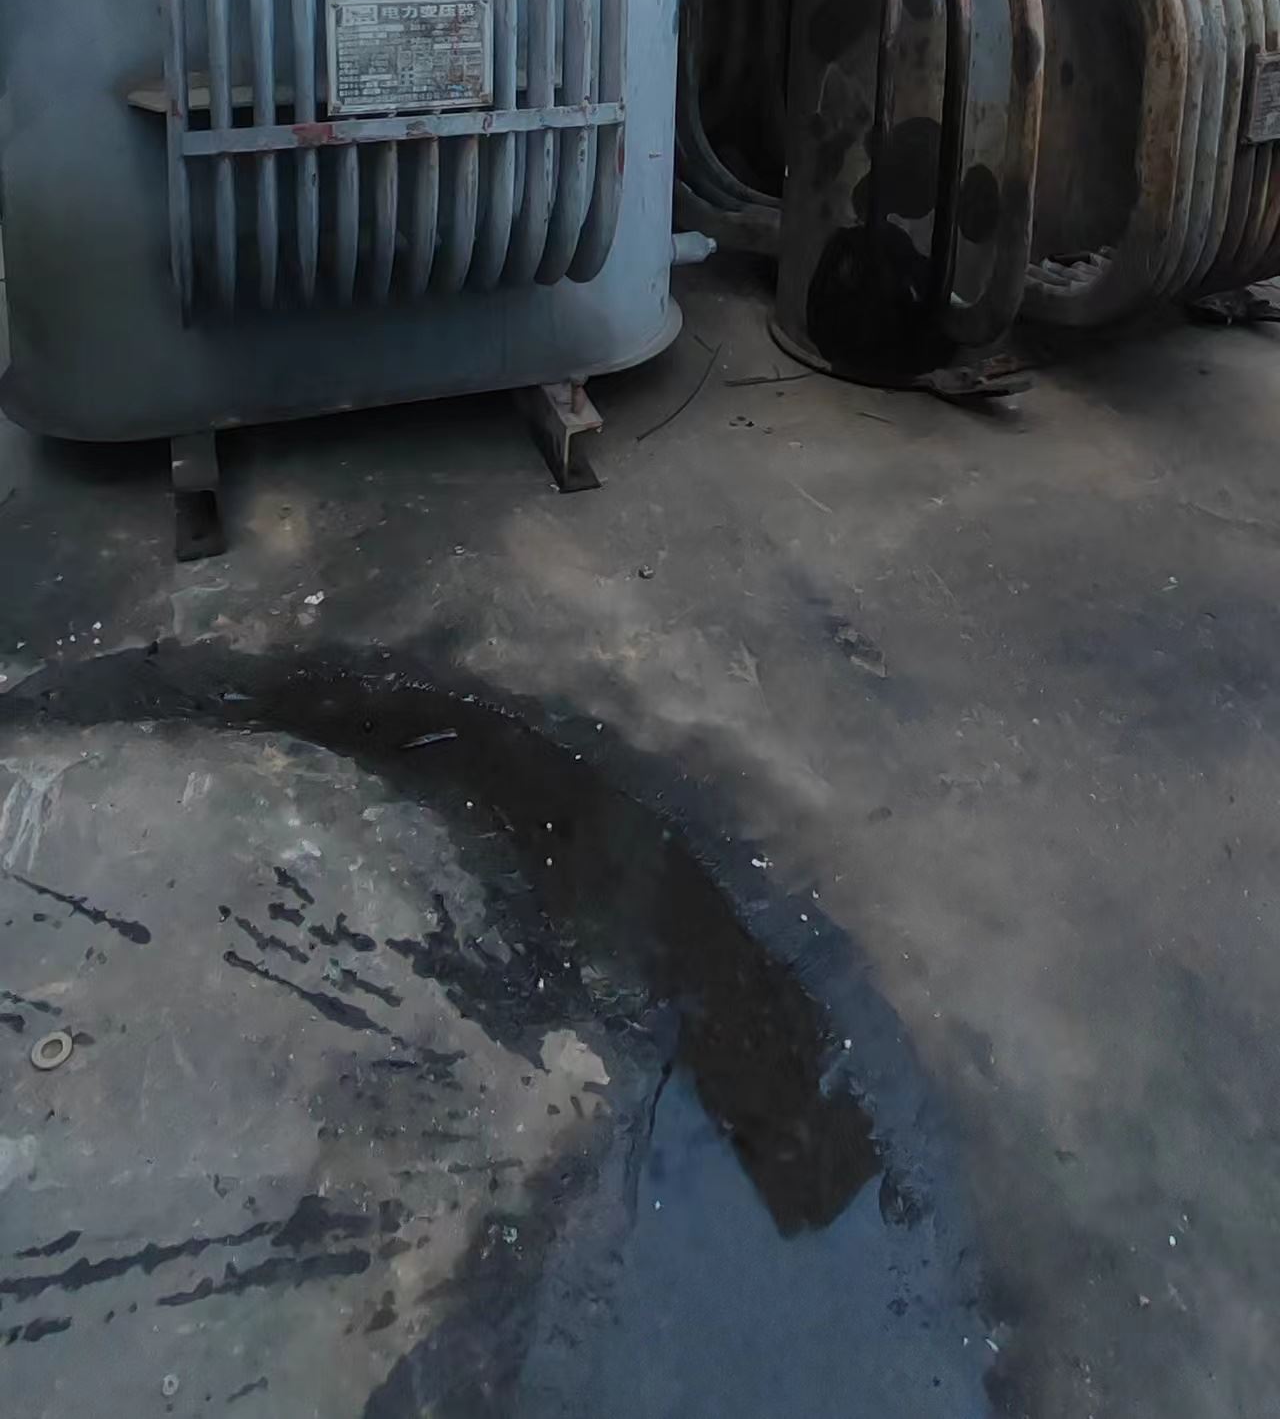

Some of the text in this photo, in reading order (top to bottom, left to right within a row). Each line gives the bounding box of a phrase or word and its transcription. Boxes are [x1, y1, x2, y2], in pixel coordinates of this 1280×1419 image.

[382, 3, 477, 19] 电力变压器
